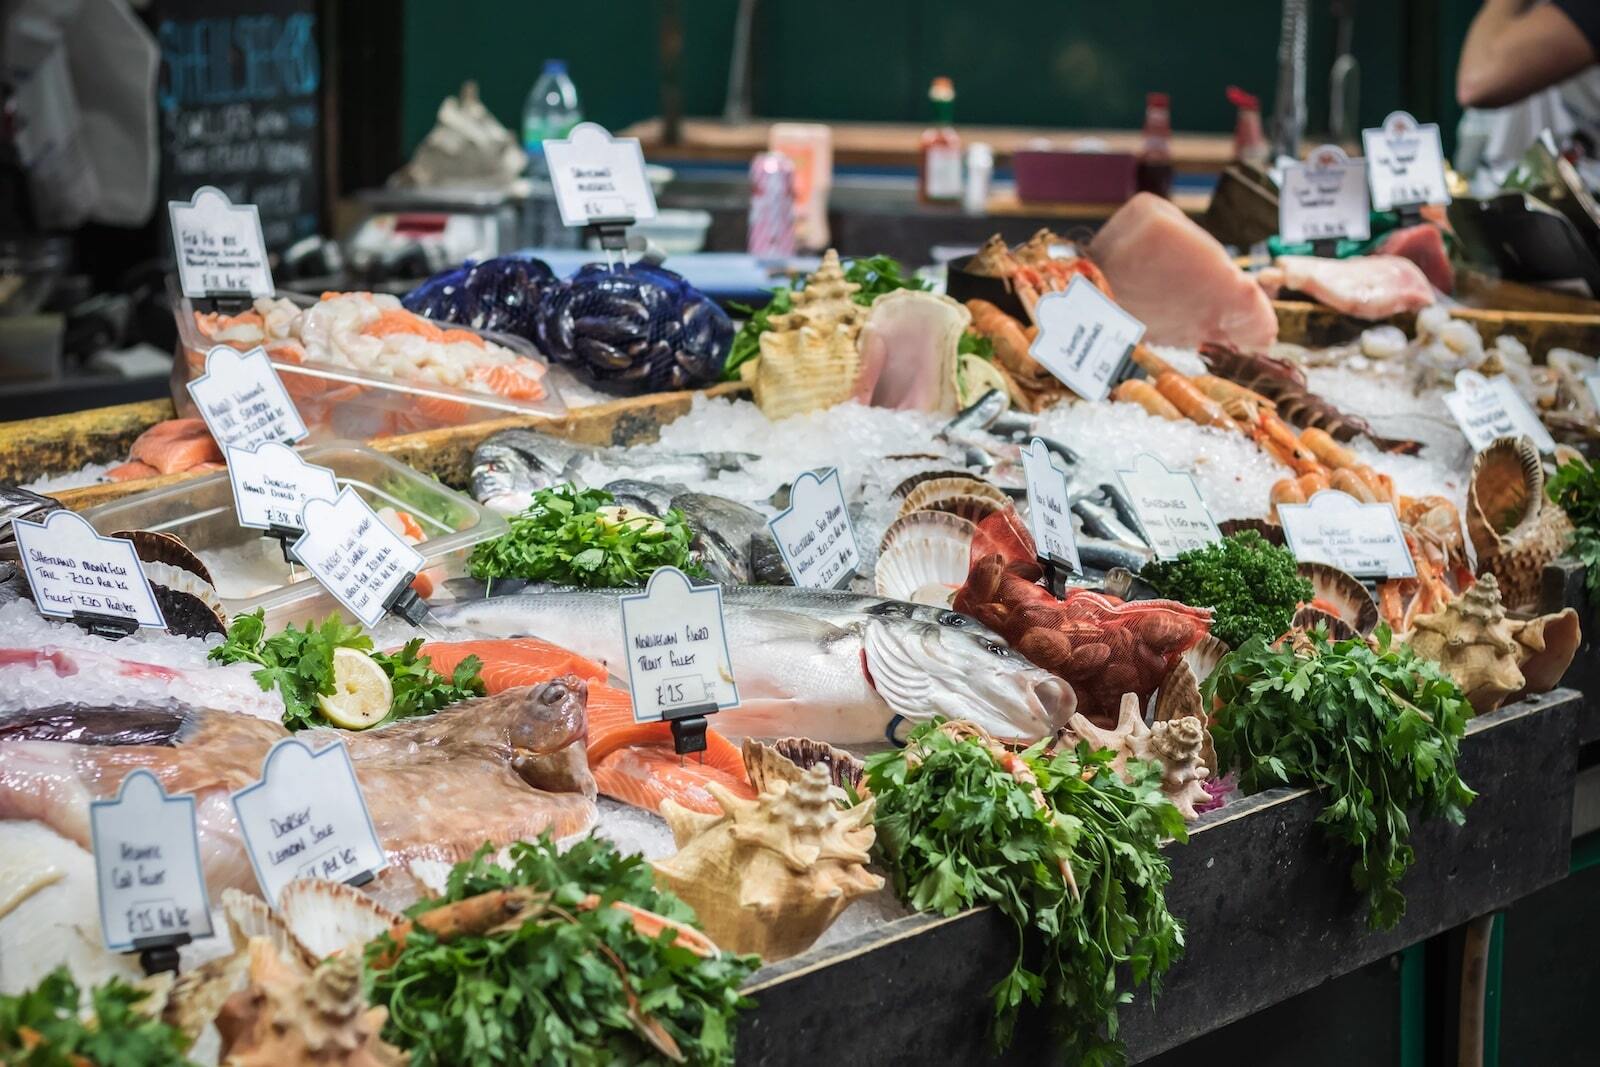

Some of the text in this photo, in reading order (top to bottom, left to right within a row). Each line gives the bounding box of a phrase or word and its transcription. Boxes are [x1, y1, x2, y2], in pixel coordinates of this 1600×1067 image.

[30, 548, 128, 577] SHETLAND MONKFISH
[35, 566, 62, 581] TAIL
[96, 576, 115, 591] PER
[43, 587, 74, 605] FILLET
[105, 597, 122, 612] PER
[634, 630, 679, 650] NORWEGIAN
[637, 649, 696, 672] TROUT FILLET
[269, 805, 312, 840] DORSET
[267, 823, 336, 866] LEMON SOLE
